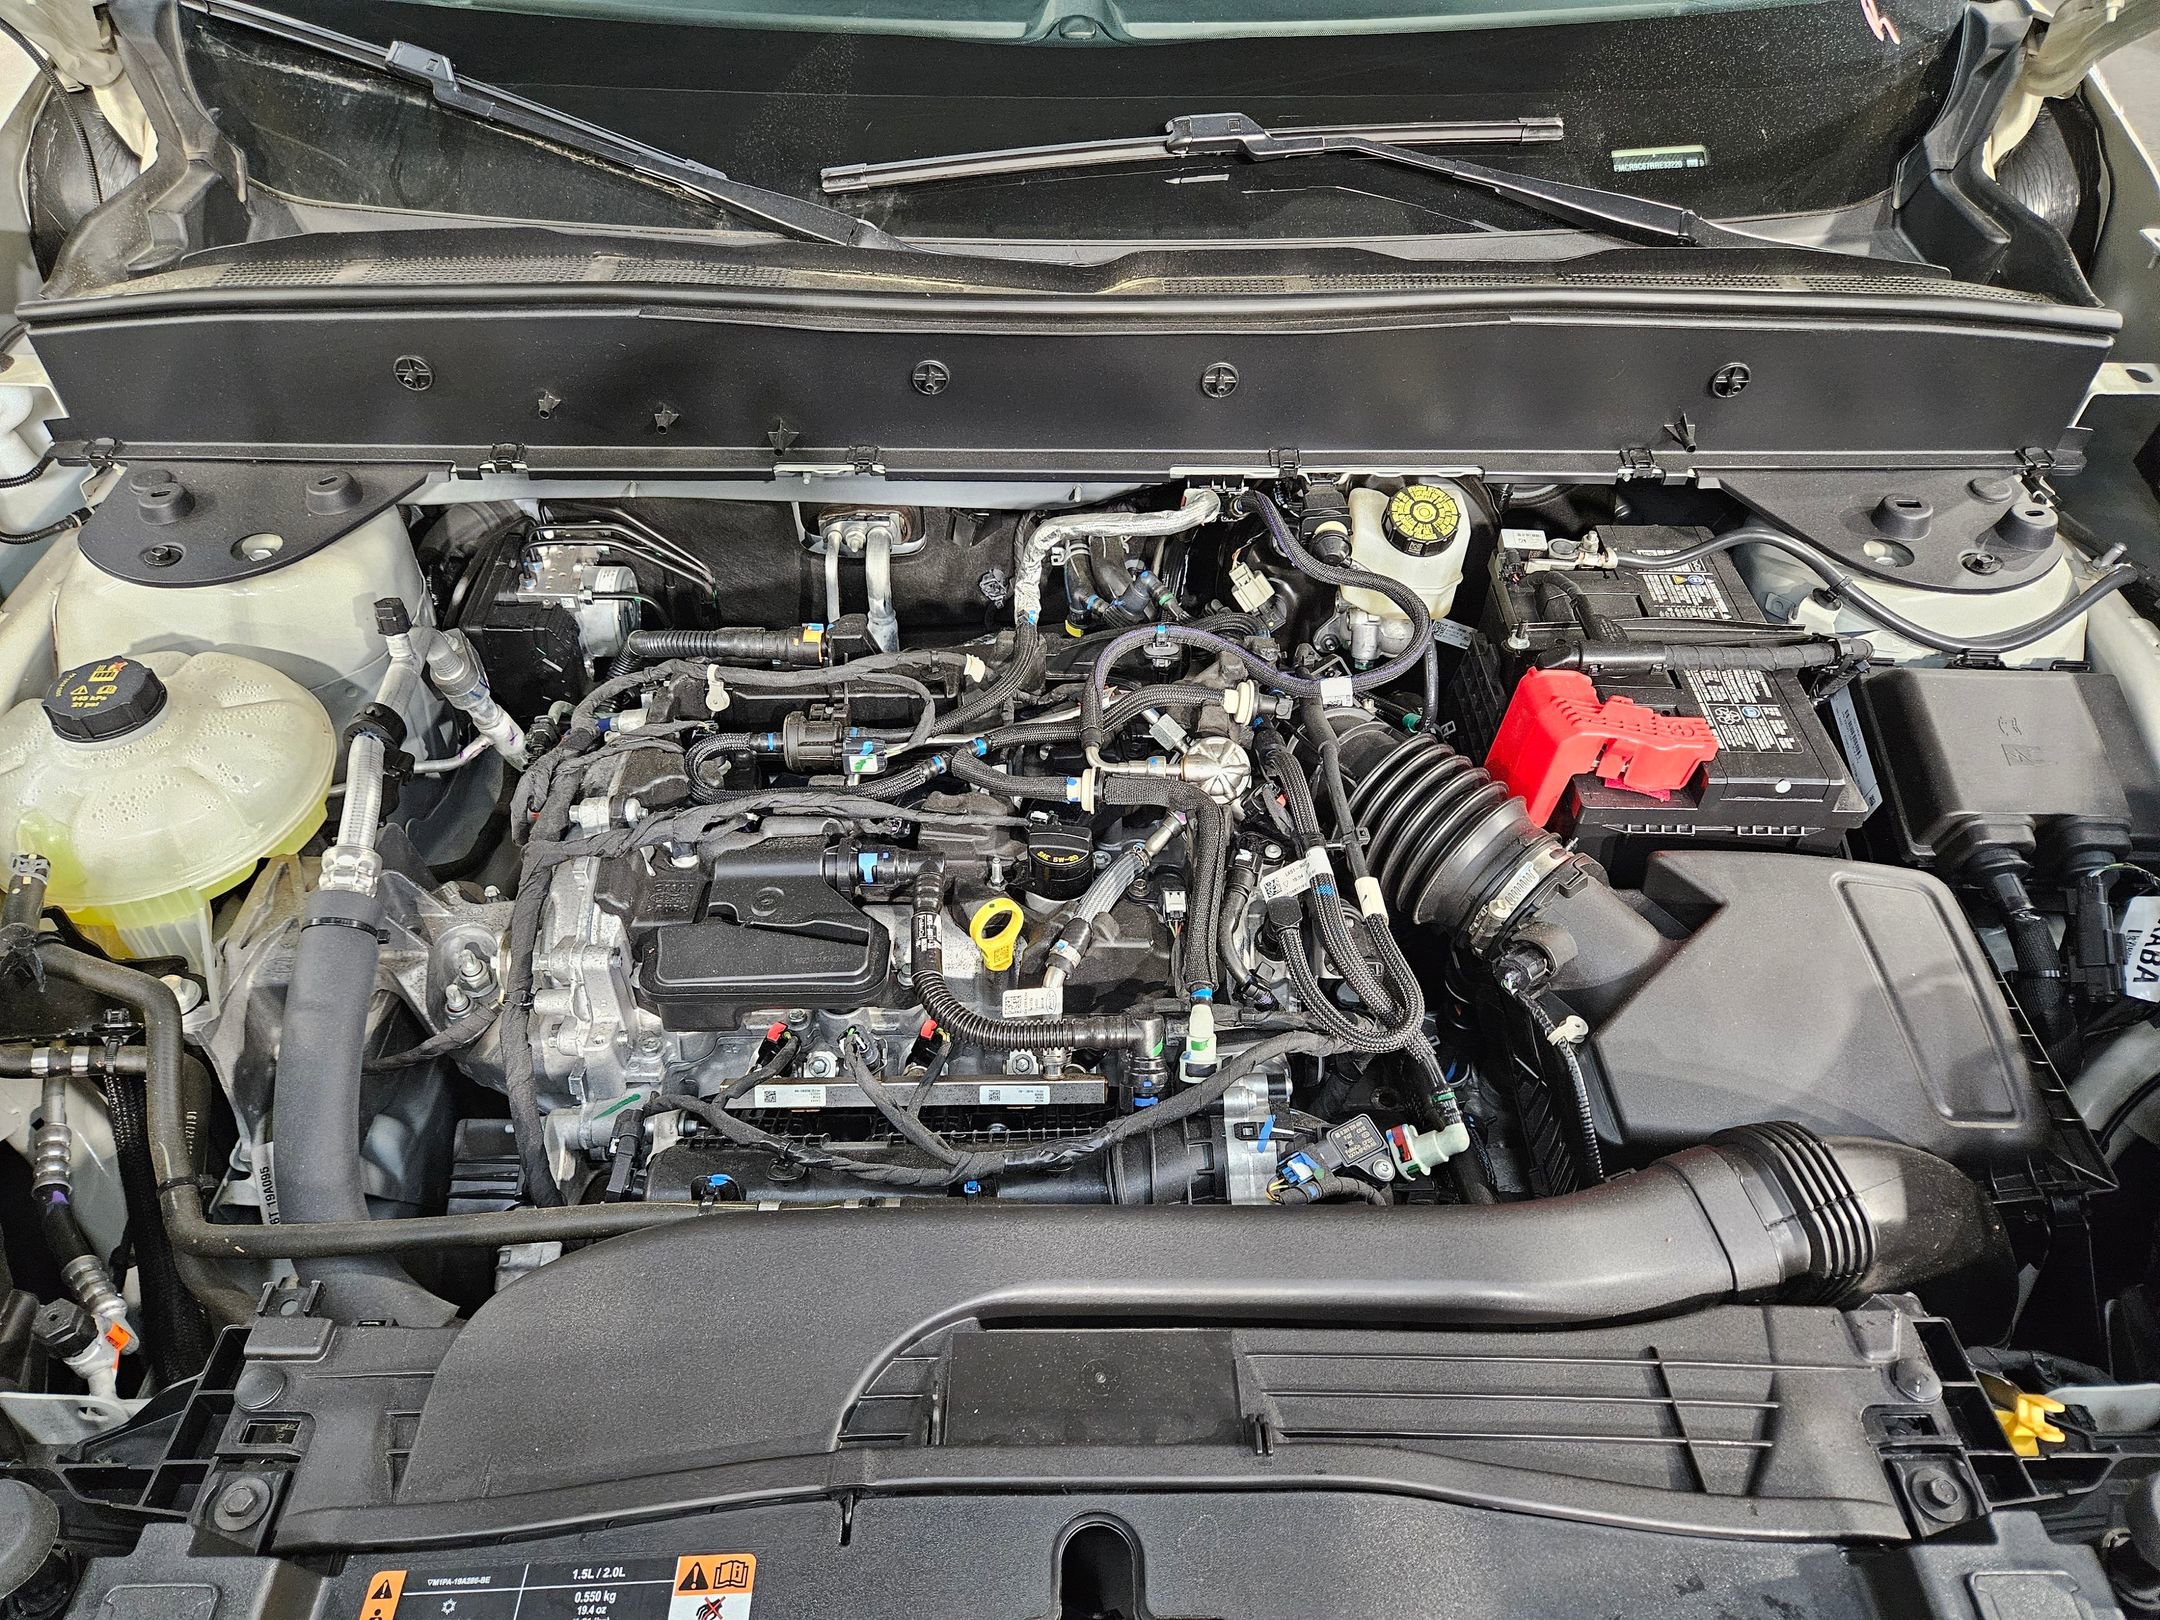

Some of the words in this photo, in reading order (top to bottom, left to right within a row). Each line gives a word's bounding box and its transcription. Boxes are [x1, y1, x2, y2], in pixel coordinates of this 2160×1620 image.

[1037, 851, 1051, 861] SAE
[260, 1166, 277, 1207] 19A095
[572, 1568, 594, 1580] 1.5L
[596, 1567, 602, 1579] /
[602, 1566, 626, 1578] 2.0L
[574, 1591, 601, 1603] 0.550
[603, 1590, 617, 1604] kg
[577, 1605, 595, 1615] 19.4
[595, 1606, 607, 1614] oz
